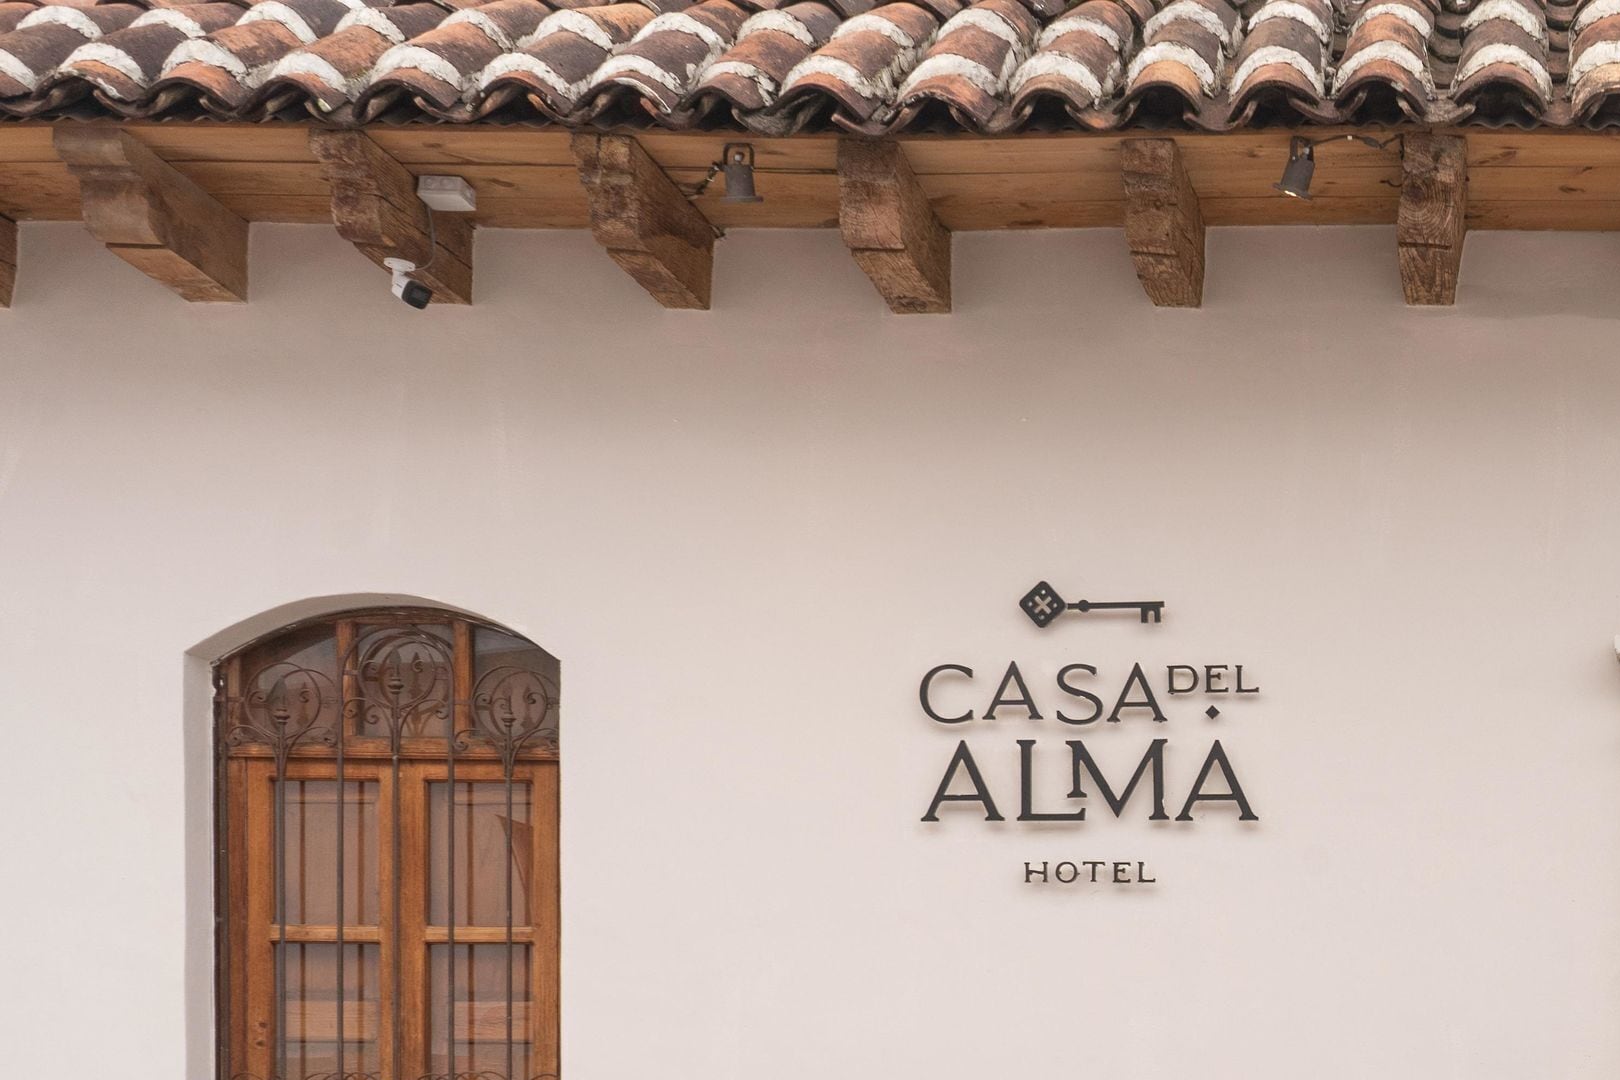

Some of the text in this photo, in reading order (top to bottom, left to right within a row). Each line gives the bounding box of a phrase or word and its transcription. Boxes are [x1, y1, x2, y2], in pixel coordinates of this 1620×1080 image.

[919, 660, 1260, 725] CASA DEL
[920, 739, 1259, 822] ALMA
[1023, 861, 1156, 884] HOTEL
